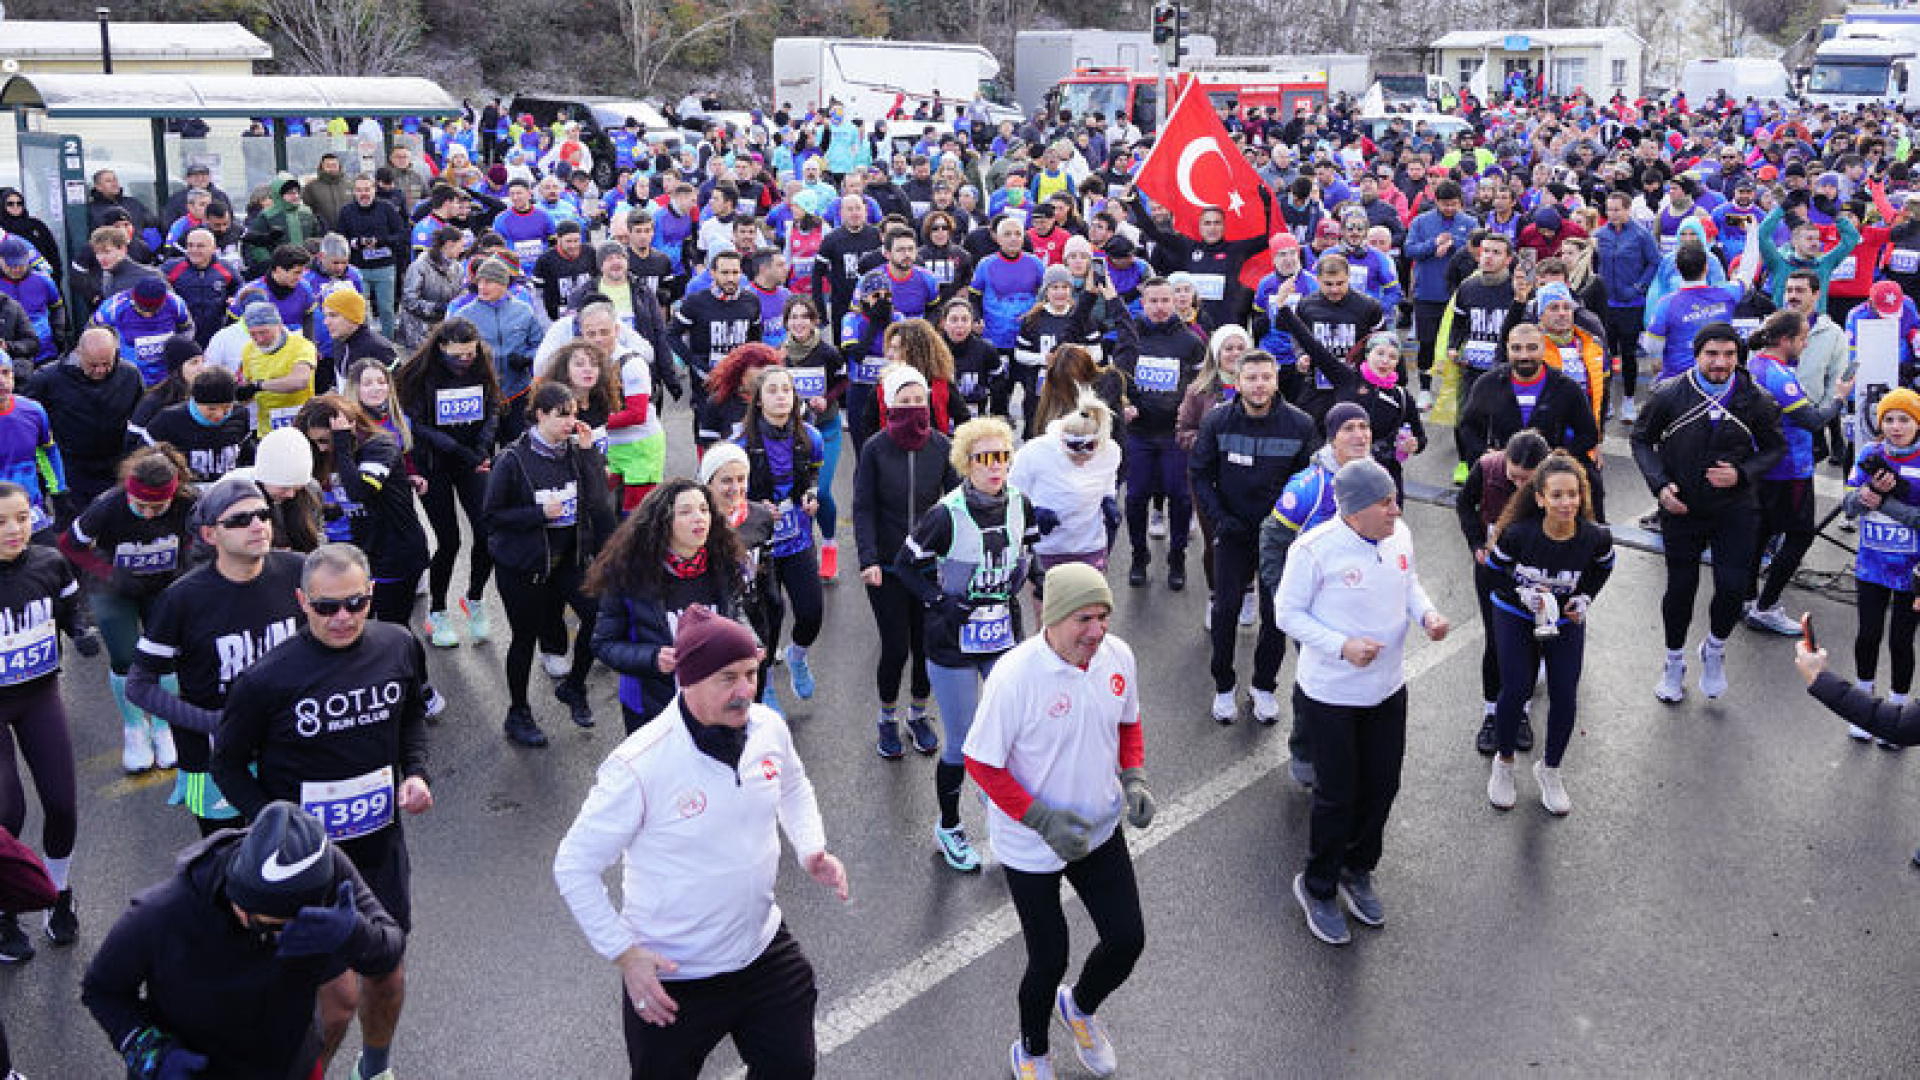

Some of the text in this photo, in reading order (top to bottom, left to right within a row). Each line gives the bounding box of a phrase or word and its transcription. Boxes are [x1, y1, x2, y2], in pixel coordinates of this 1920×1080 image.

[441, 398, 480, 415] 0399
[1865, 521, 1910, 543] 1179
[328, 708, 390, 732] RUN CLUB
[306, 792, 389, 828] 1399
